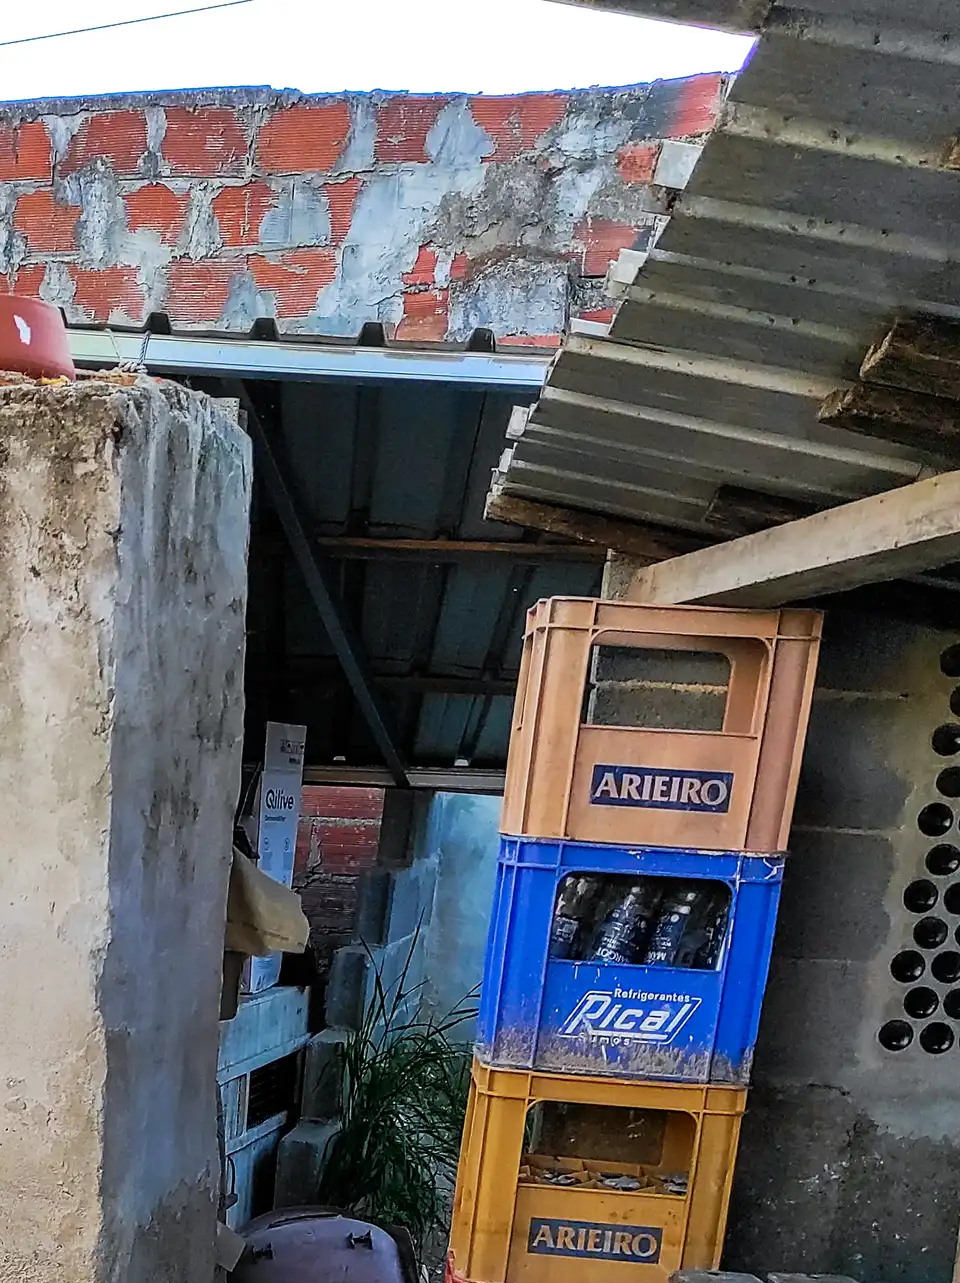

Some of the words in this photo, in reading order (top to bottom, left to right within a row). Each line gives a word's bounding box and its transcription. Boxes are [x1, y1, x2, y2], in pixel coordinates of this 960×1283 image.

[265, 788, 294, 810] Qilive
[594, 772, 728, 806] ARIEIRO
[613, 988, 690, 1003] Refrigerantes
[531, 1224, 657, 1257] ARIEIRO
